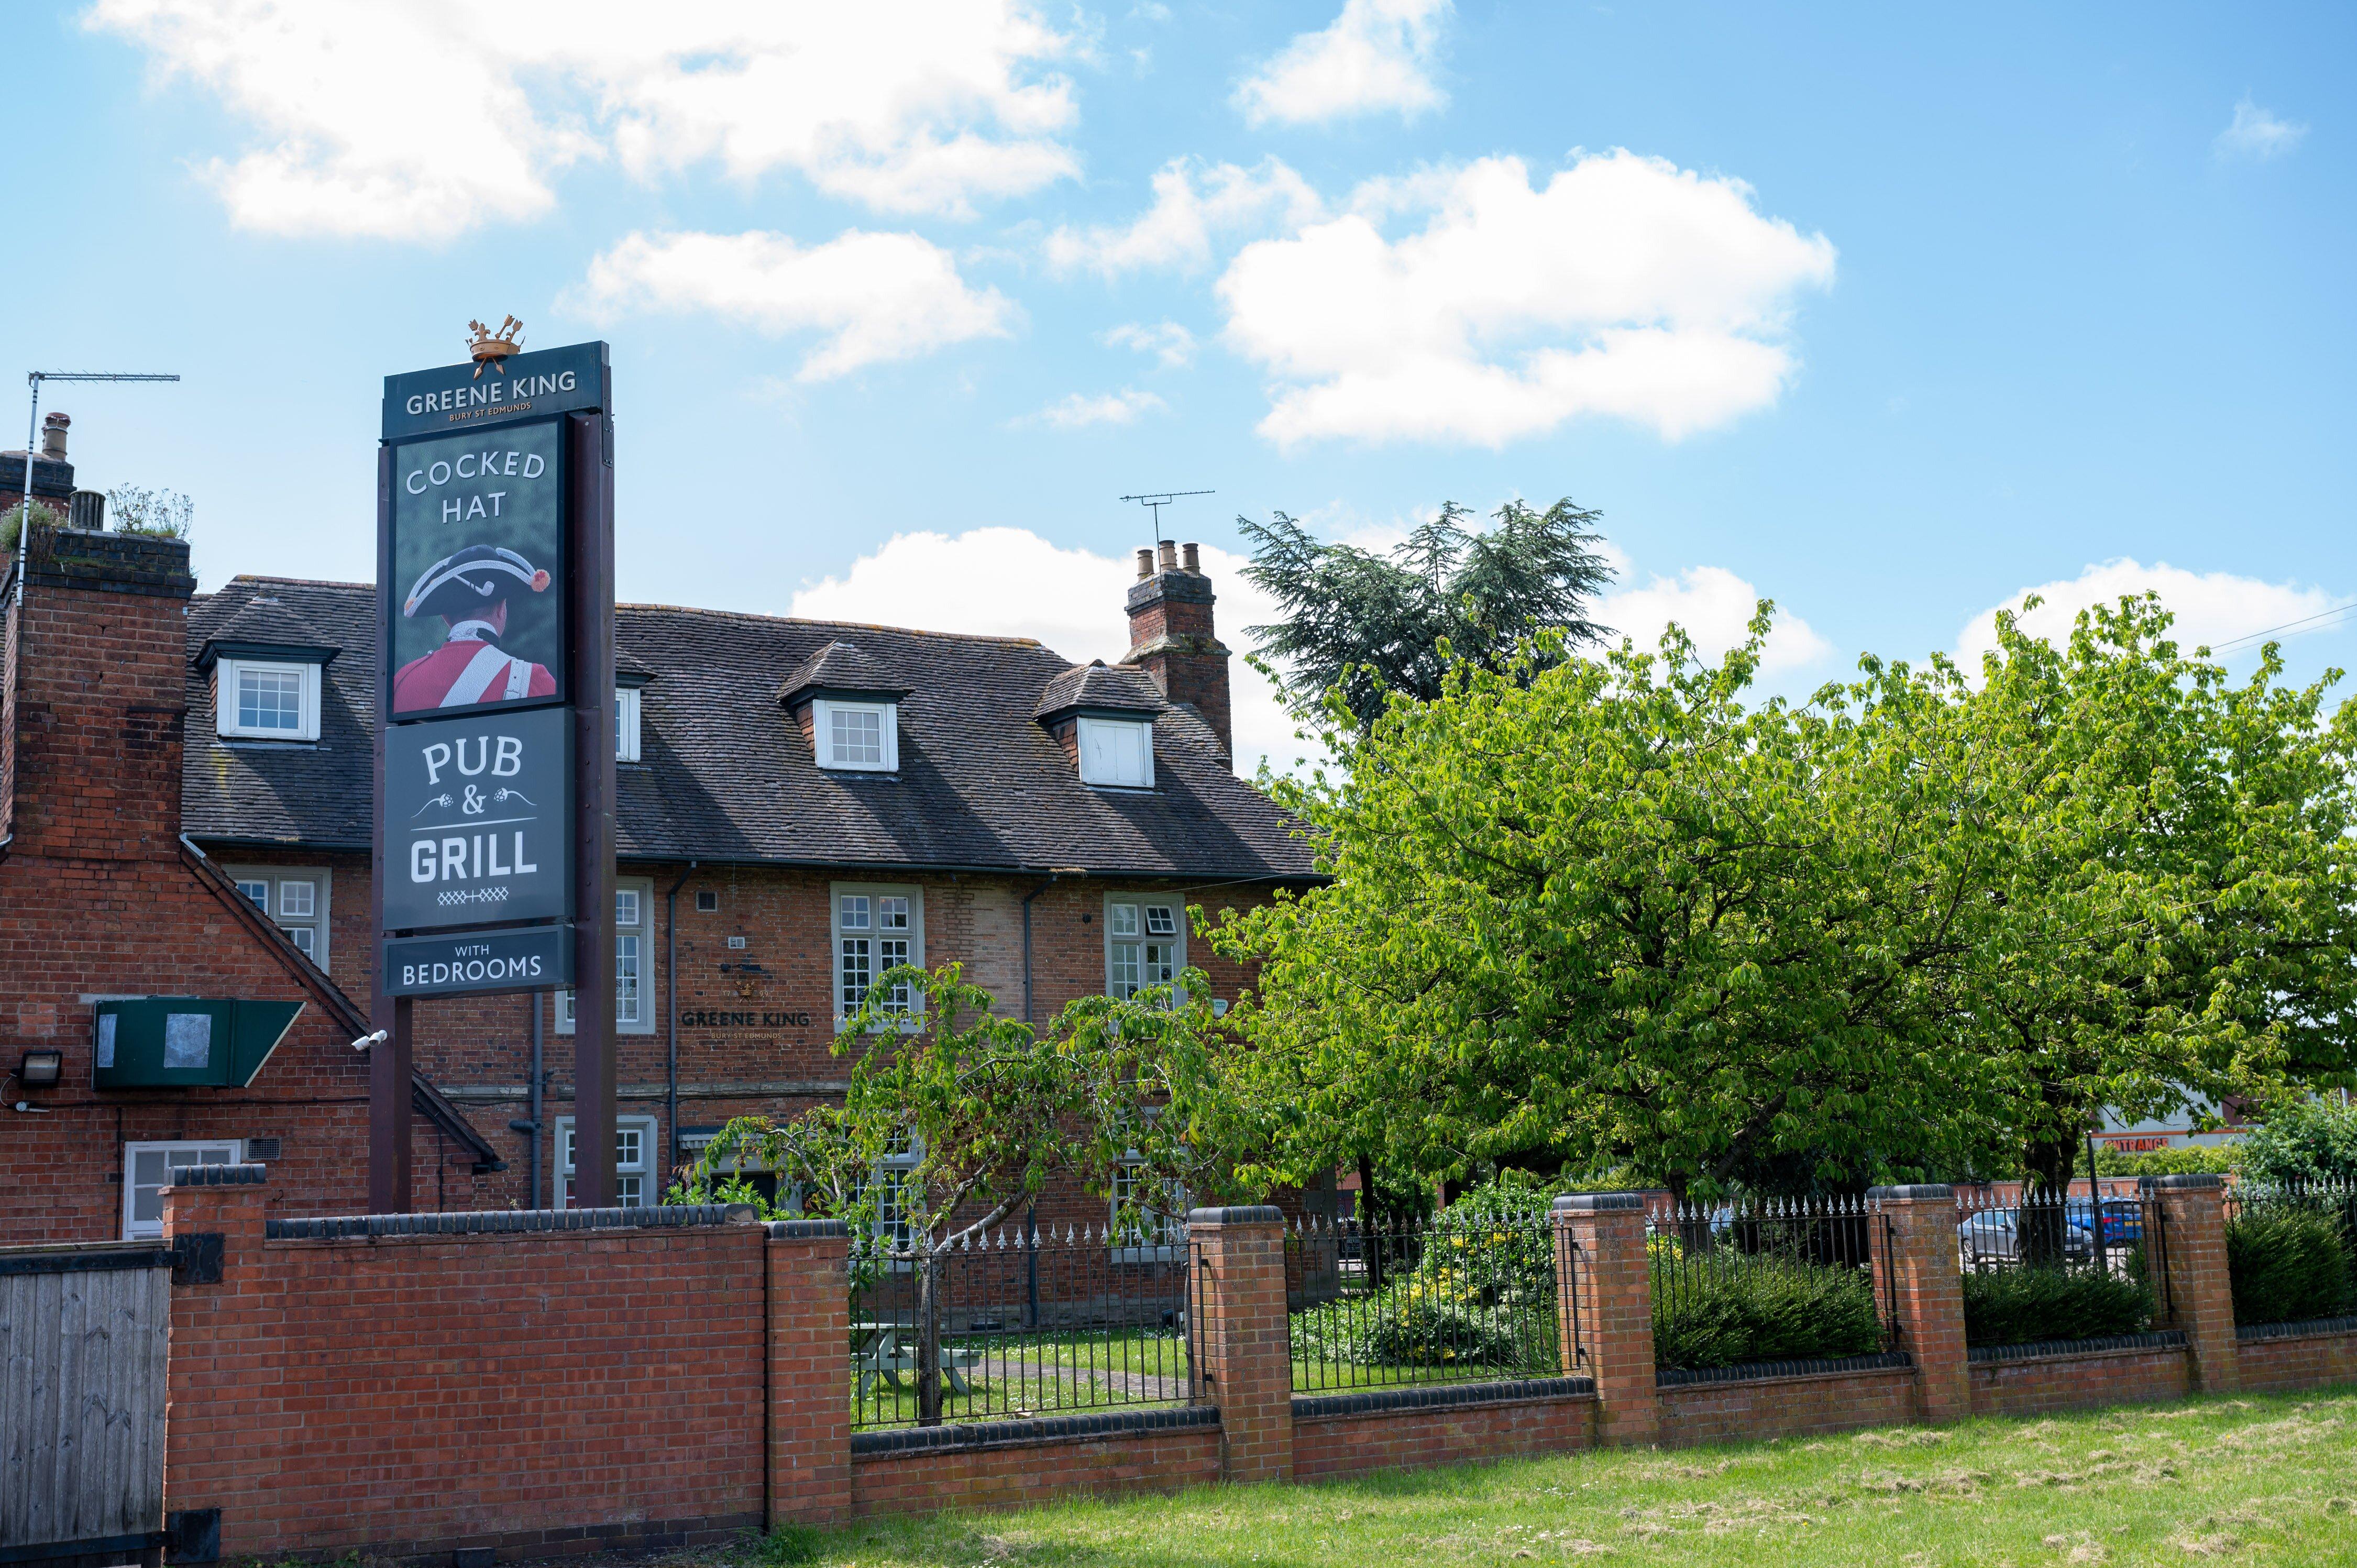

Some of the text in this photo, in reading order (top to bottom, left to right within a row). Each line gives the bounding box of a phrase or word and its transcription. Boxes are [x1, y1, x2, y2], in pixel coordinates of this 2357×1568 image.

[406, 371, 576, 415] GREENE KING
[449, 402, 532, 422] BURY ST EDMUNDS
[406, 451, 545, 495] COCKED
[442, 491, 506, 524] HAT
[422, 735, 523, 786] PUB
[462, 784, 487, 815] &
[410, 831, 537, 884] GRILL
[455, 944, 489, 957] WITH
[403, 955, 542, 986] BEDROOMS
[681, 1011, 810, 1026] GREENE KING
